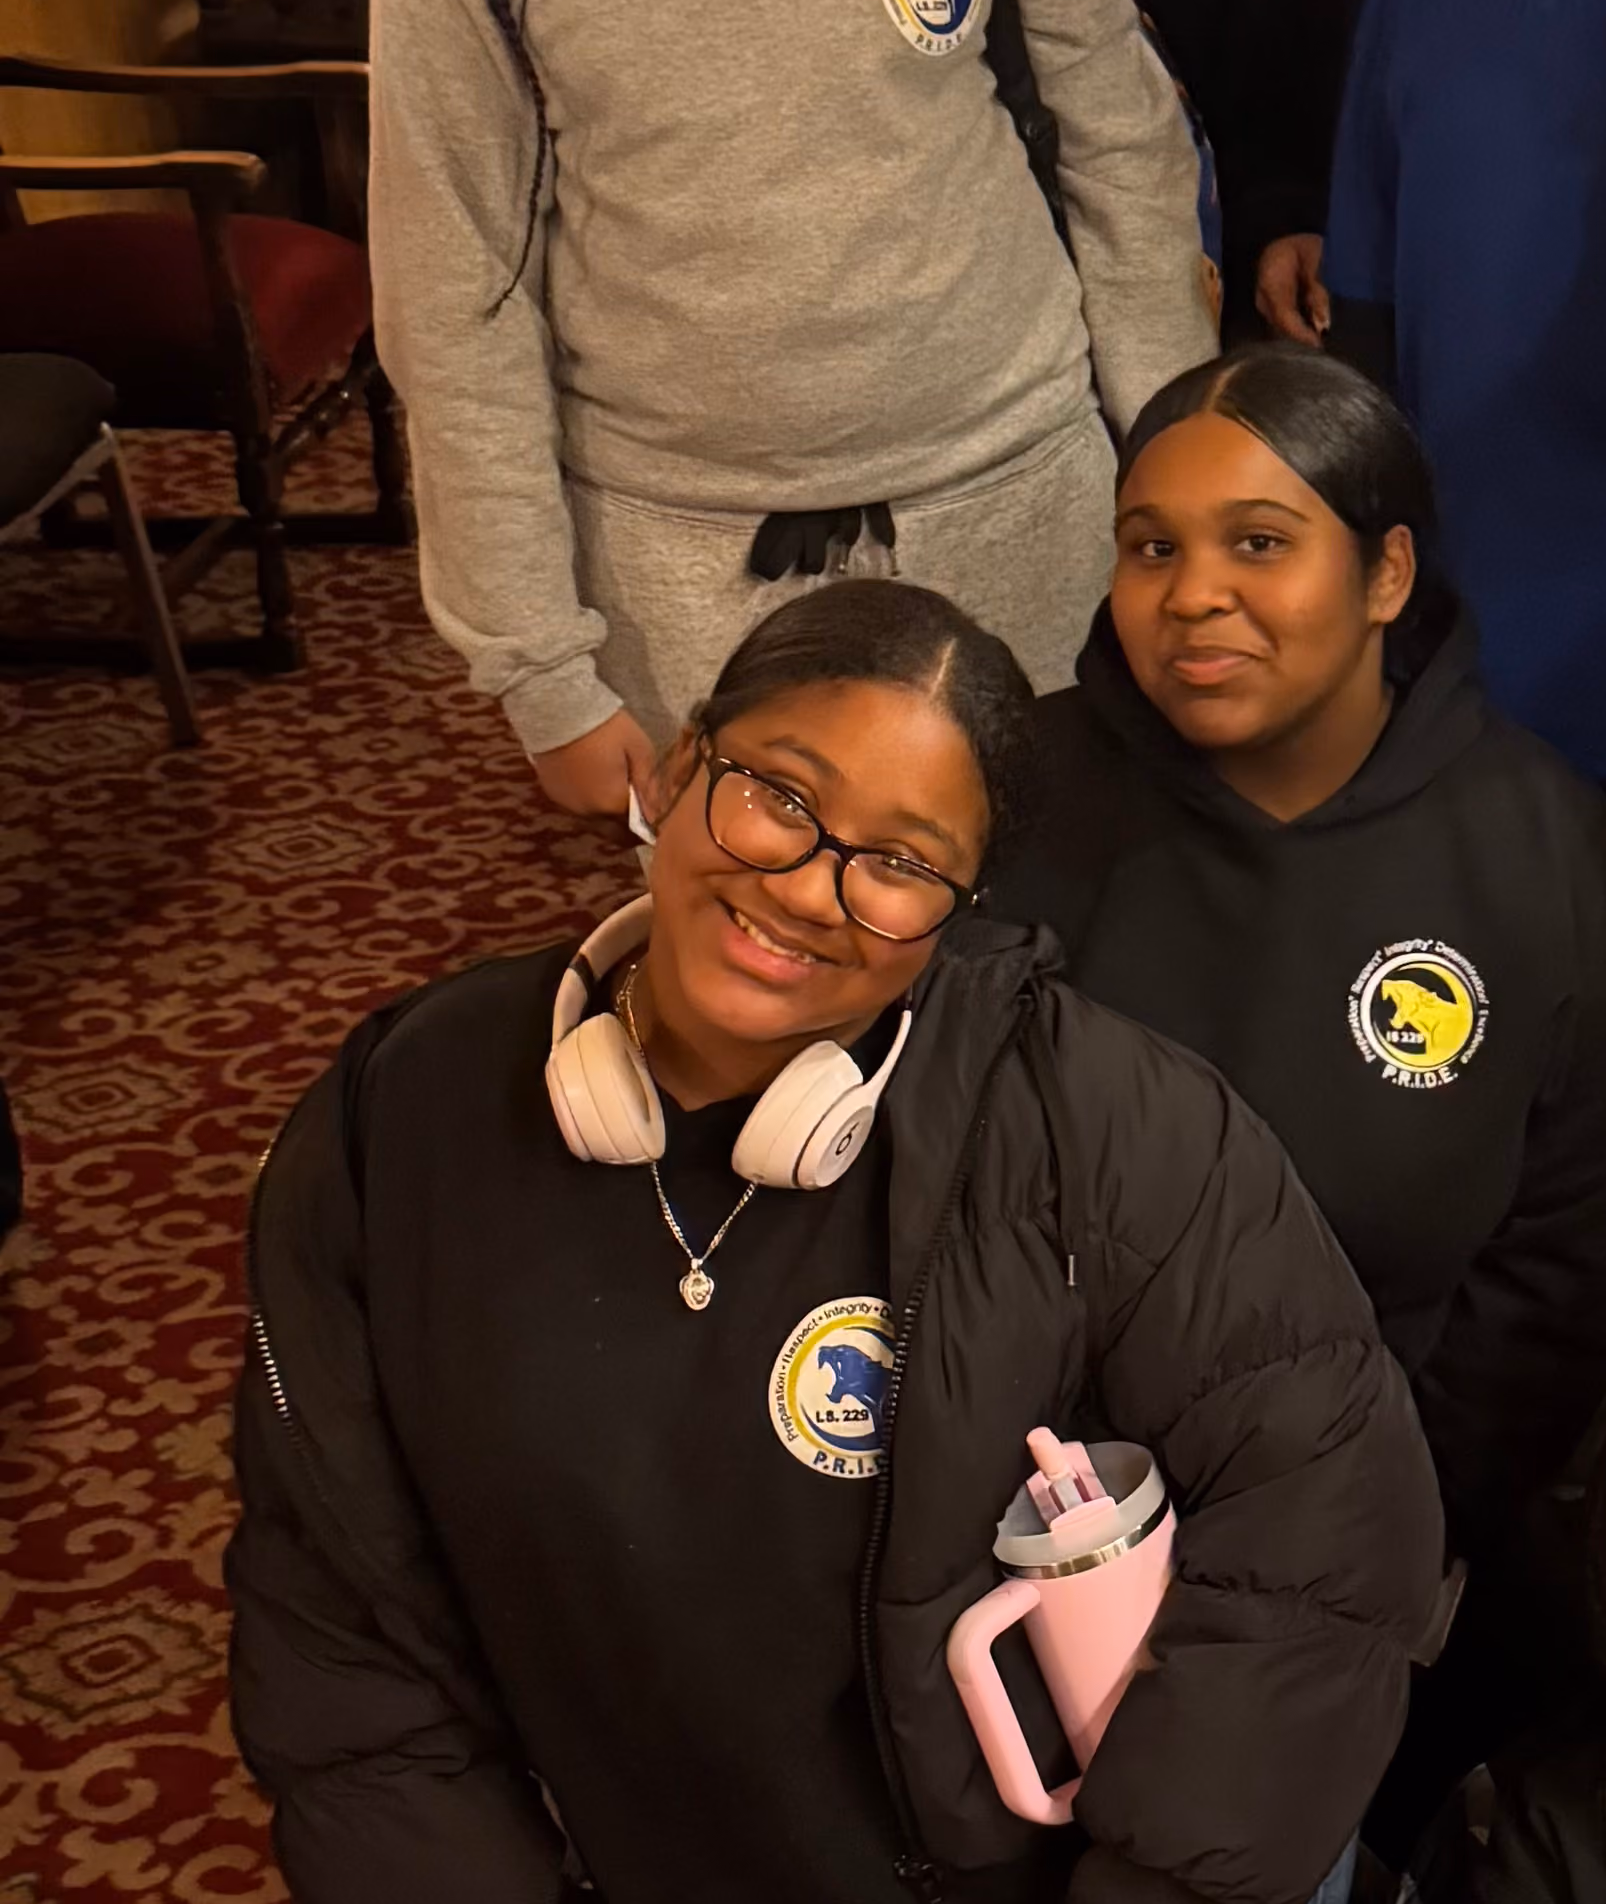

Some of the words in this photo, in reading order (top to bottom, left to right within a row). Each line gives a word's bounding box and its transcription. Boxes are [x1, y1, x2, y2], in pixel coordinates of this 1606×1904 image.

[1381, 1063, 1459, 1089] P.R.I.D.E.
[823, 1301, 874, 1320] Integrity
[842, 1409, 870, 1424] 229
